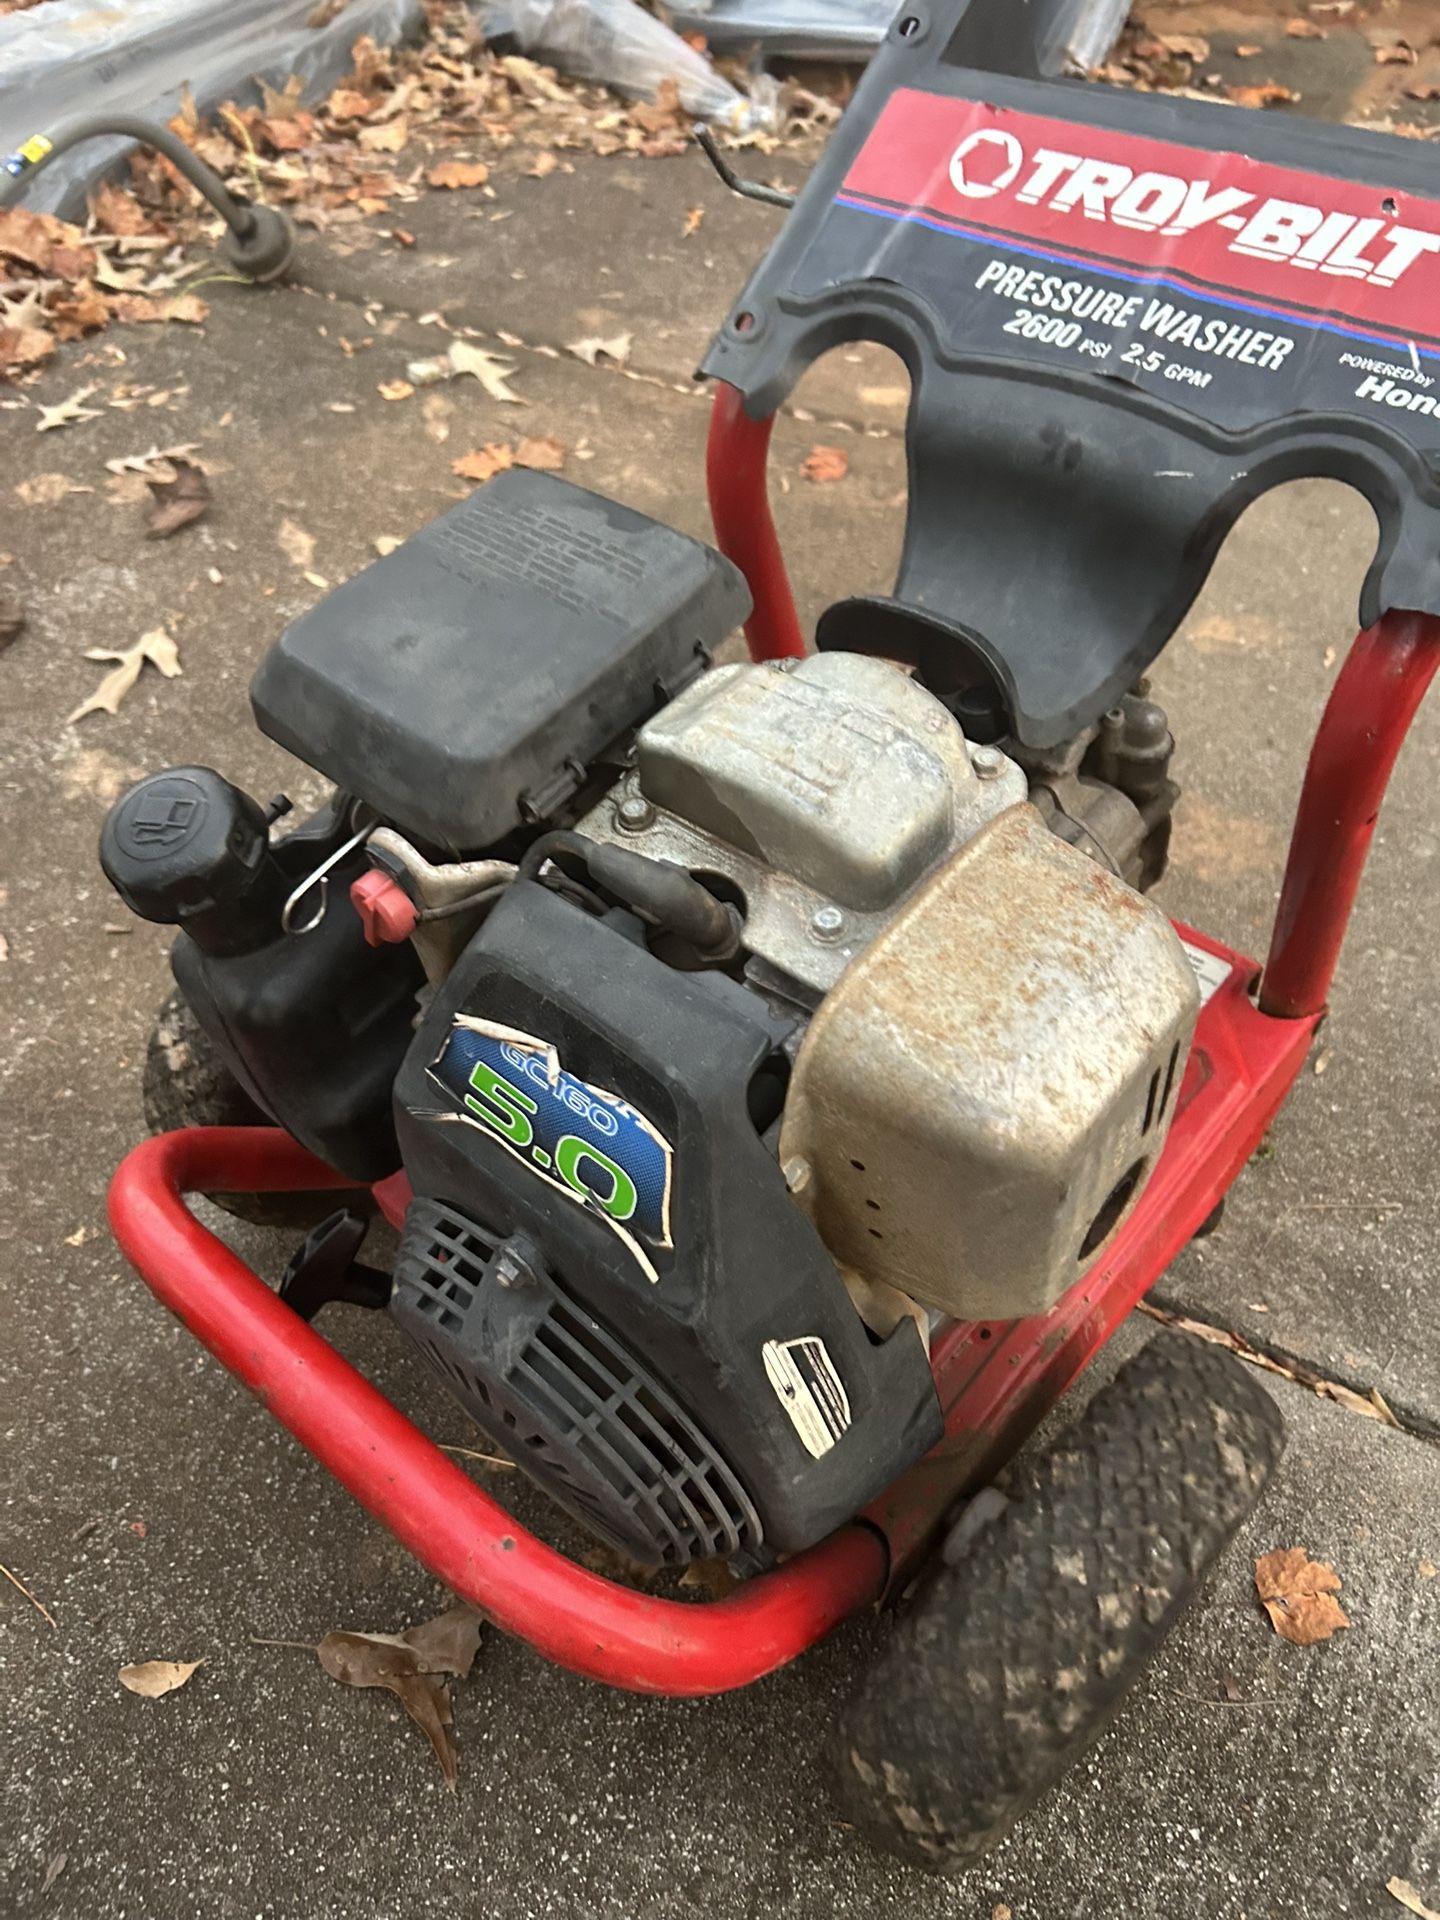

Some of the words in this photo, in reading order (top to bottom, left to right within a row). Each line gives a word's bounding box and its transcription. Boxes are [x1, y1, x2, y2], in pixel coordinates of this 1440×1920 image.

[1015, 147, 1440, 288] TROY-BILT
[974, 260, 1144, 328] PRESSURE
[1138, 298, 1295, 371] WASHER
[1002, 309, 1082, 349] 2600
[1078, 338, 1113, 360] PSI
[1120, 342, 1166, 373] 2.5
[1163, 363, 1213, 389] GPM
[1338, 352, 1416, 381] POWERED
[464, 1060, 638, 1220] 5.0
